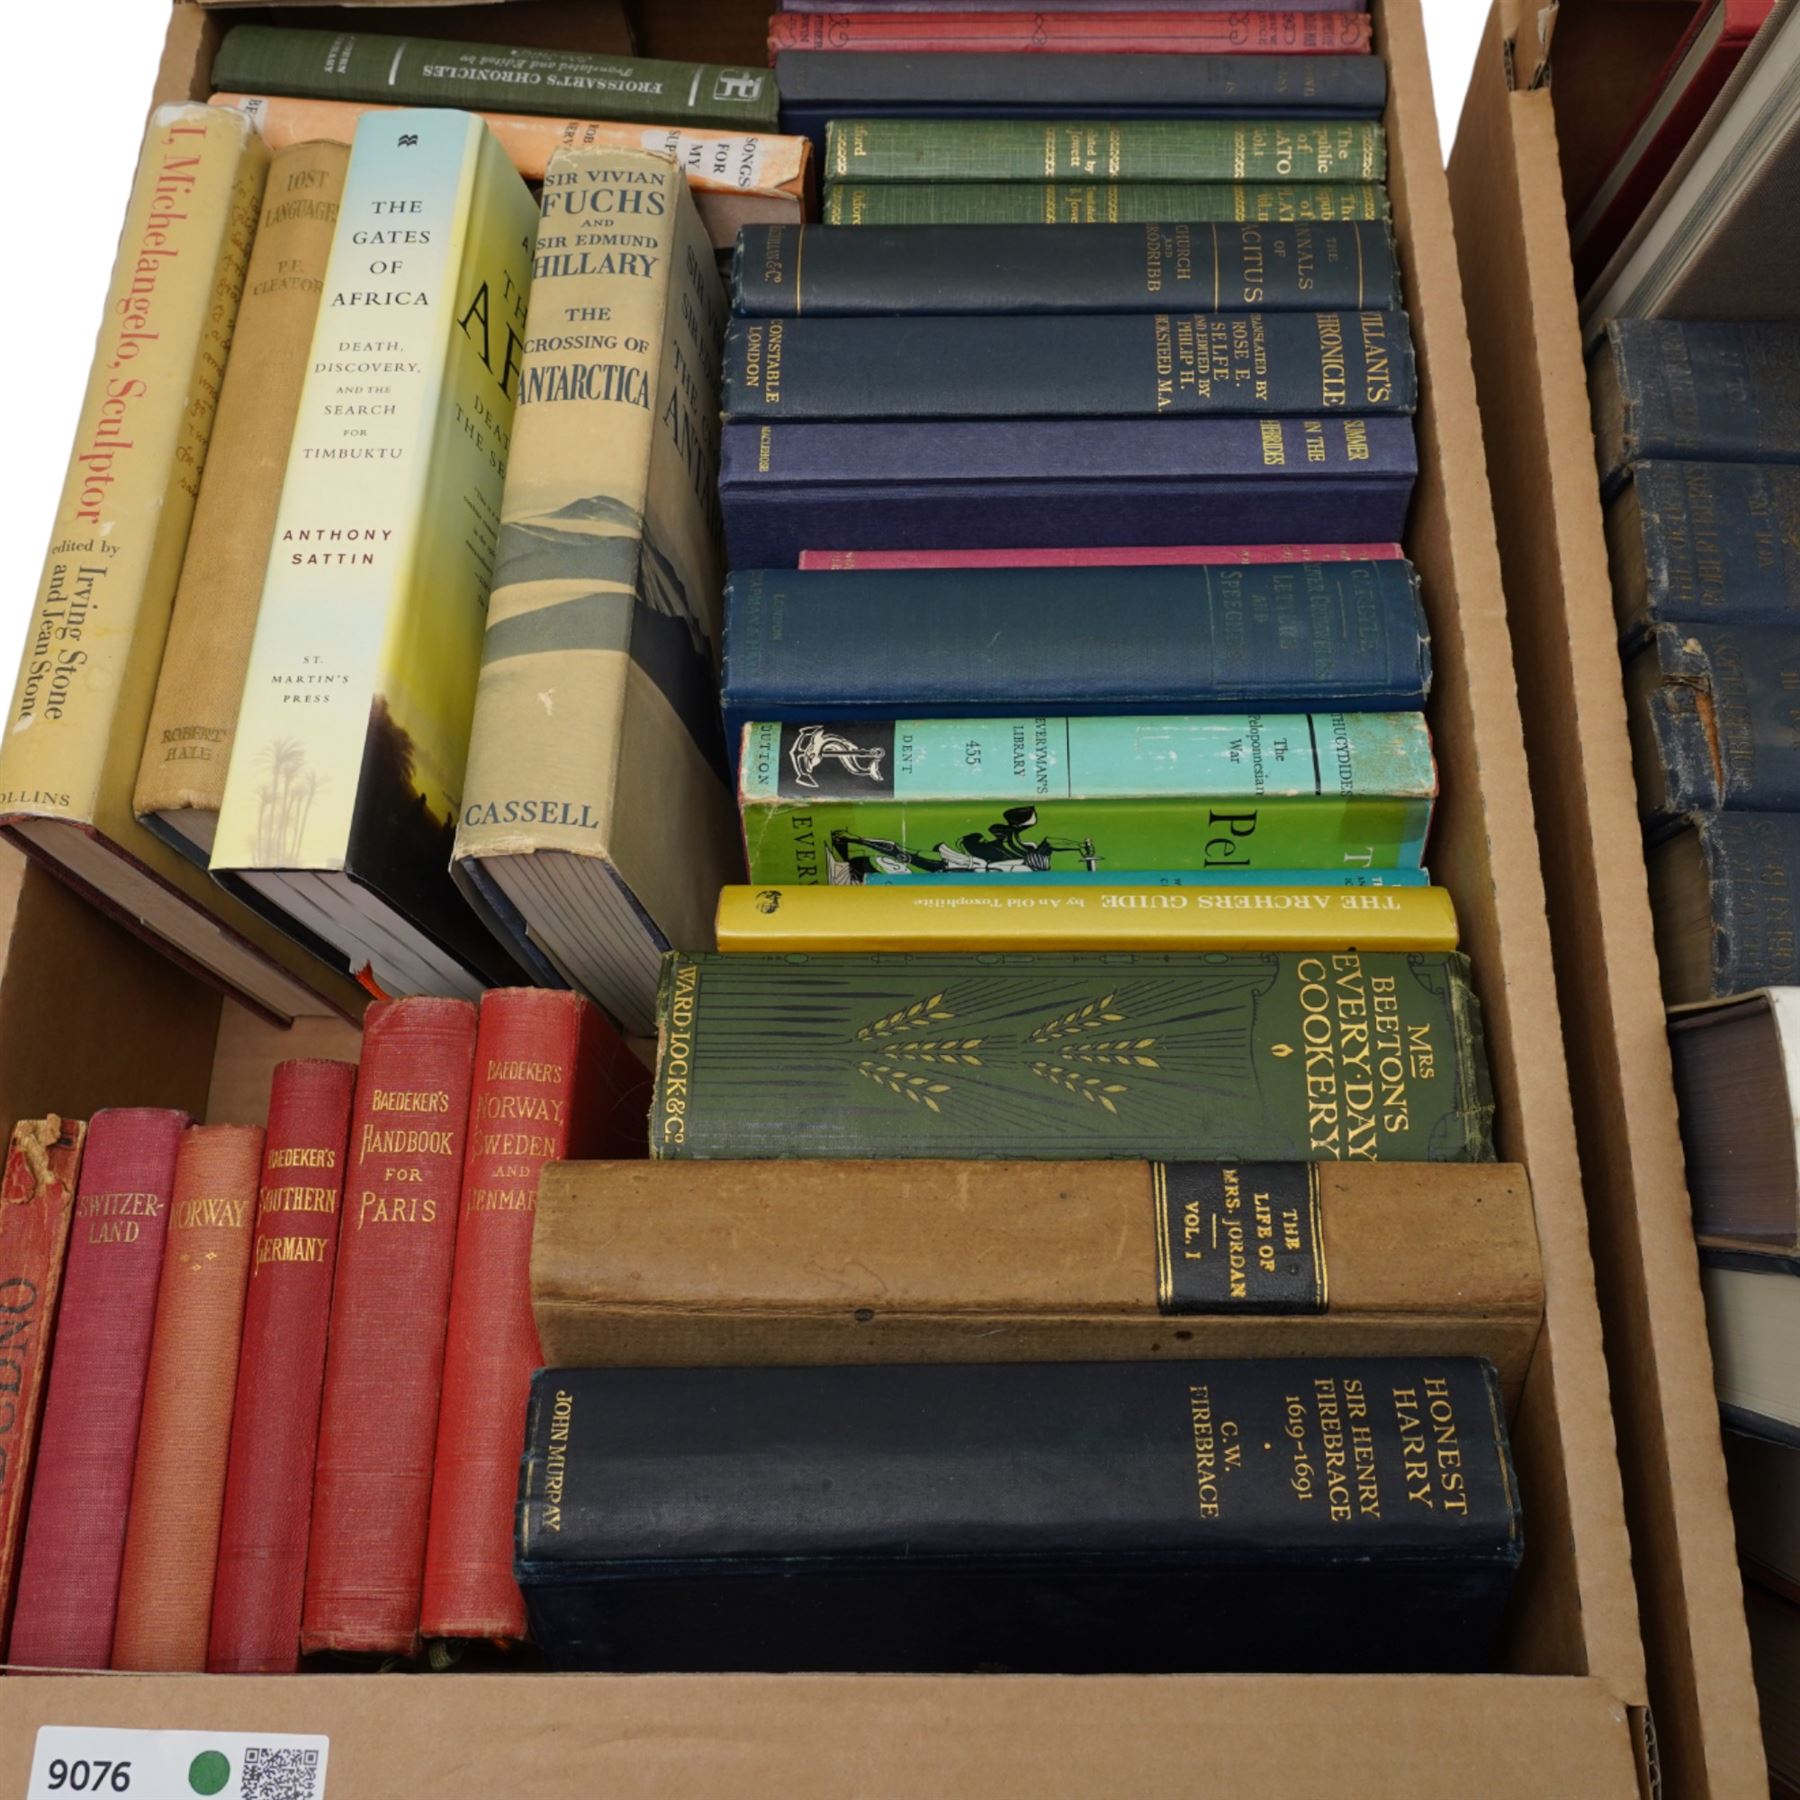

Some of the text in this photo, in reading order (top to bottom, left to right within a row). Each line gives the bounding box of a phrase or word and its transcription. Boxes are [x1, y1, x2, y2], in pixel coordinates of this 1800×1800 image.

[423, 64, 663, 95] FROISSART'S CHRONICLES
[1297, 133, 1313, 154] of
[687, 144, 704, 169] MY
[712, 143, 731, 174] FOR
[737, 136, 759, 188] SONGS
[285, 169, 330, 193] LOST
[544, 170, 666, 188] SIR VIVIAN
[371, 200, 424, 215] THE
[539, 188, 666, 218] FUCHS
[580, 218, 615, 229] AND
[352, 230, 432, 245] GATES
[535, 235, 568, 250] SIR
[574, 233, 659, 250] EDMUND
[1273, 239, 1287, 258] OF
[1325, 236, 1339, 262] THE
[105, 154, 201, 371] Michelangelo,
[368, 260, 404, 275] OF
[531, 252, 661, 281] HILLARY
[330, 291, 431, 308] AFRICA
[564, 306, 612, 323] THE
[337, 341, 405, 354] DEATH,
[523, 334, 651, 355] CROSSING OF
[745, 326, 763, 388] LONDON
[1176, 321, 1196, 391] PHILIP H.
[1195, 331, 1211, 375] EDITED
[1210, 321, 1230, 382] SELFE
[1231, 320, 1251, 388] ROSE E.
[313, 362, 422, 375] DISCOVERY,
[336, 385, 392, 395] AND THE
[517, 363, 651, 412] ANTARCTICA
[1156, 378, 1174, 414] M.A.
[1198, 379, 1211, 399] BY
[1255, 379, 1268, 401] BY
[323, 404, 397, 416] SEARCH
[343, 428, 369, 437] FOR
[1259, 419, 1286, 466] HEBRIDES
[1303, 420, 1326, 463] IN THE
[76, 378, 148, 525] Sculptor
[302, 447, 404, 460] TIMBUKTU
[281, 528, 394, 542] ANTHONY
[52, 539, 121, 558] edited by
[290, 552, 375, 566] SATTIN
[18, 563, 69, 721] and Jean Stone
[44, 564, 107, 721] Irving Stone
[303, 655, 325, 665] ST.
[270, 674, 351, 685] MARTIN'S
[282, 693, 332, 704] PRESS
[160, 725, 225, 745] ROBERT
[164, 746, 212, 762] HALE
[900, 734, 914, 775] DENT
[965, 739, 982, 767] 455
[1012, 724, 1026, 778] LIBRARY
[1229, 738, 1243, 765] War
[1273, 737, 1289, 762] The
[464, 799, 600, 831] CASSELL
[1006, 896, 1037, 909] Old
[1039, 896, 1062, 909] An
[1065, 896, 1086, 908] by
[1100, 893, 1189, 911] GUIDE
[1197, 893, 1331, 911] ARCHERS
[1341, 894, 1402, 912] THE
[1296, 957, 1342, 1162] COOKERY
[1370, 975, 1409, 1135] BEETON'S
[487, 1060, 563, 1083] BAEDEKER'S
[371, 1089, 449, 1113] BAEDEKER'S
[359, 1123, 455, 1166] HANDBOOK
[384, 1168, 424, 1183] FOR
[492, 1166, 530, 1178] AND
[88, 1220, 140, 1244] LAND
[1183, 1200, 1202, 1260] VOL. I
[1221, 1167, 1247, 1299] MRS. JORDAN
[1253, 1192, 1276, 1273] LIFE OF
[1282, 1207, 1301, 1251] THE
[1188, 1384, 1220, 1520] FIREBRACE
[1219, 1419, 1243, 1473] C.W.
[1313, 1377, 1353, 1523] FIREBRACE
[1342, 1378, 1382, 1520] SIR HENRY
[1392, 1387, 1433, 1509] HARRY
[1422, 1376, 1468, 1516] HONEST
[541, 1389, 574, 1532] JOHN MURRAY
[47, 1758, 132, 1793] 9076
